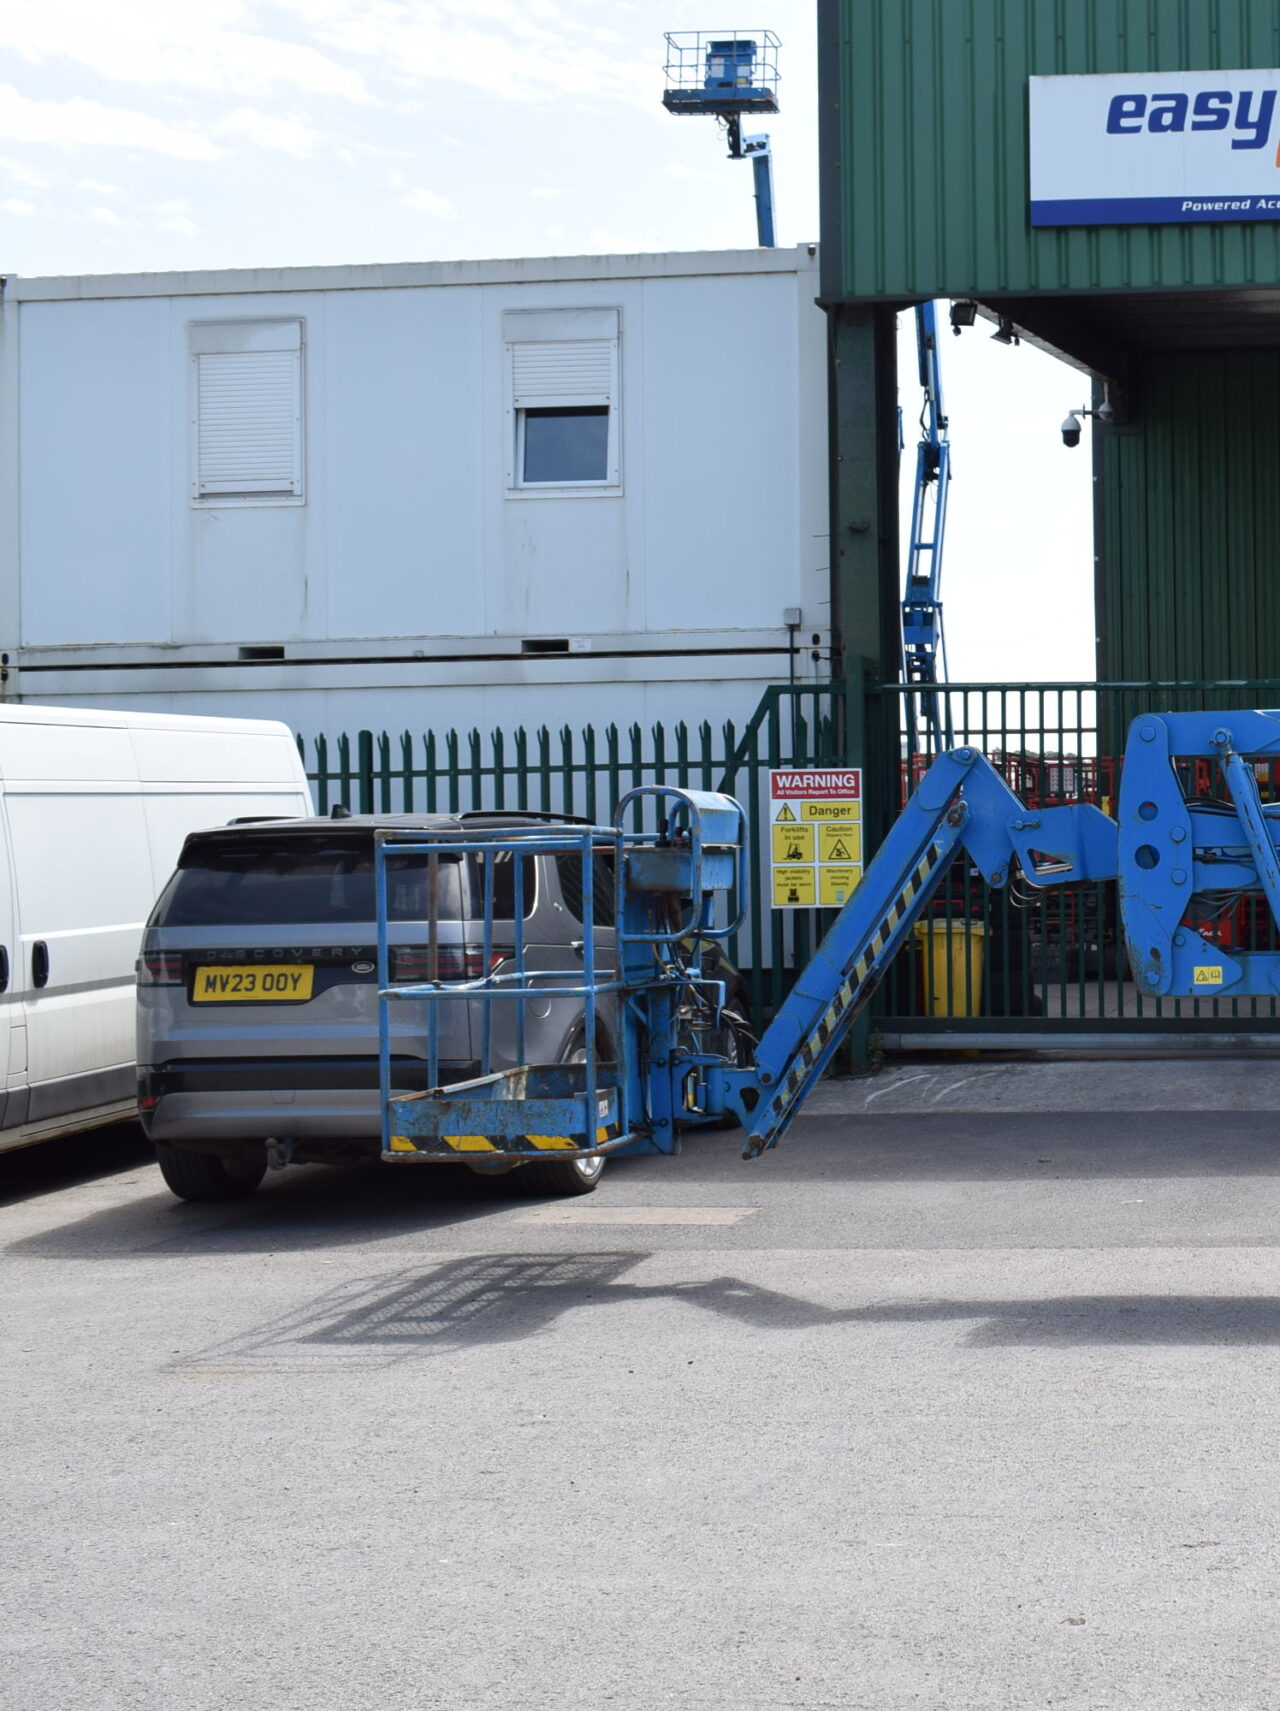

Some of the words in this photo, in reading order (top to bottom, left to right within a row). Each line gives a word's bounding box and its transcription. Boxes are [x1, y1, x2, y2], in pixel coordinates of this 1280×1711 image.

[1181, 199, 1251, 212] Powered
[775, 774, 855, 788] WARNING
[809, 805, 852, 818] Danger
[204, 974, 257, 993] MV23
[261, 972, 303, 992] OOY
